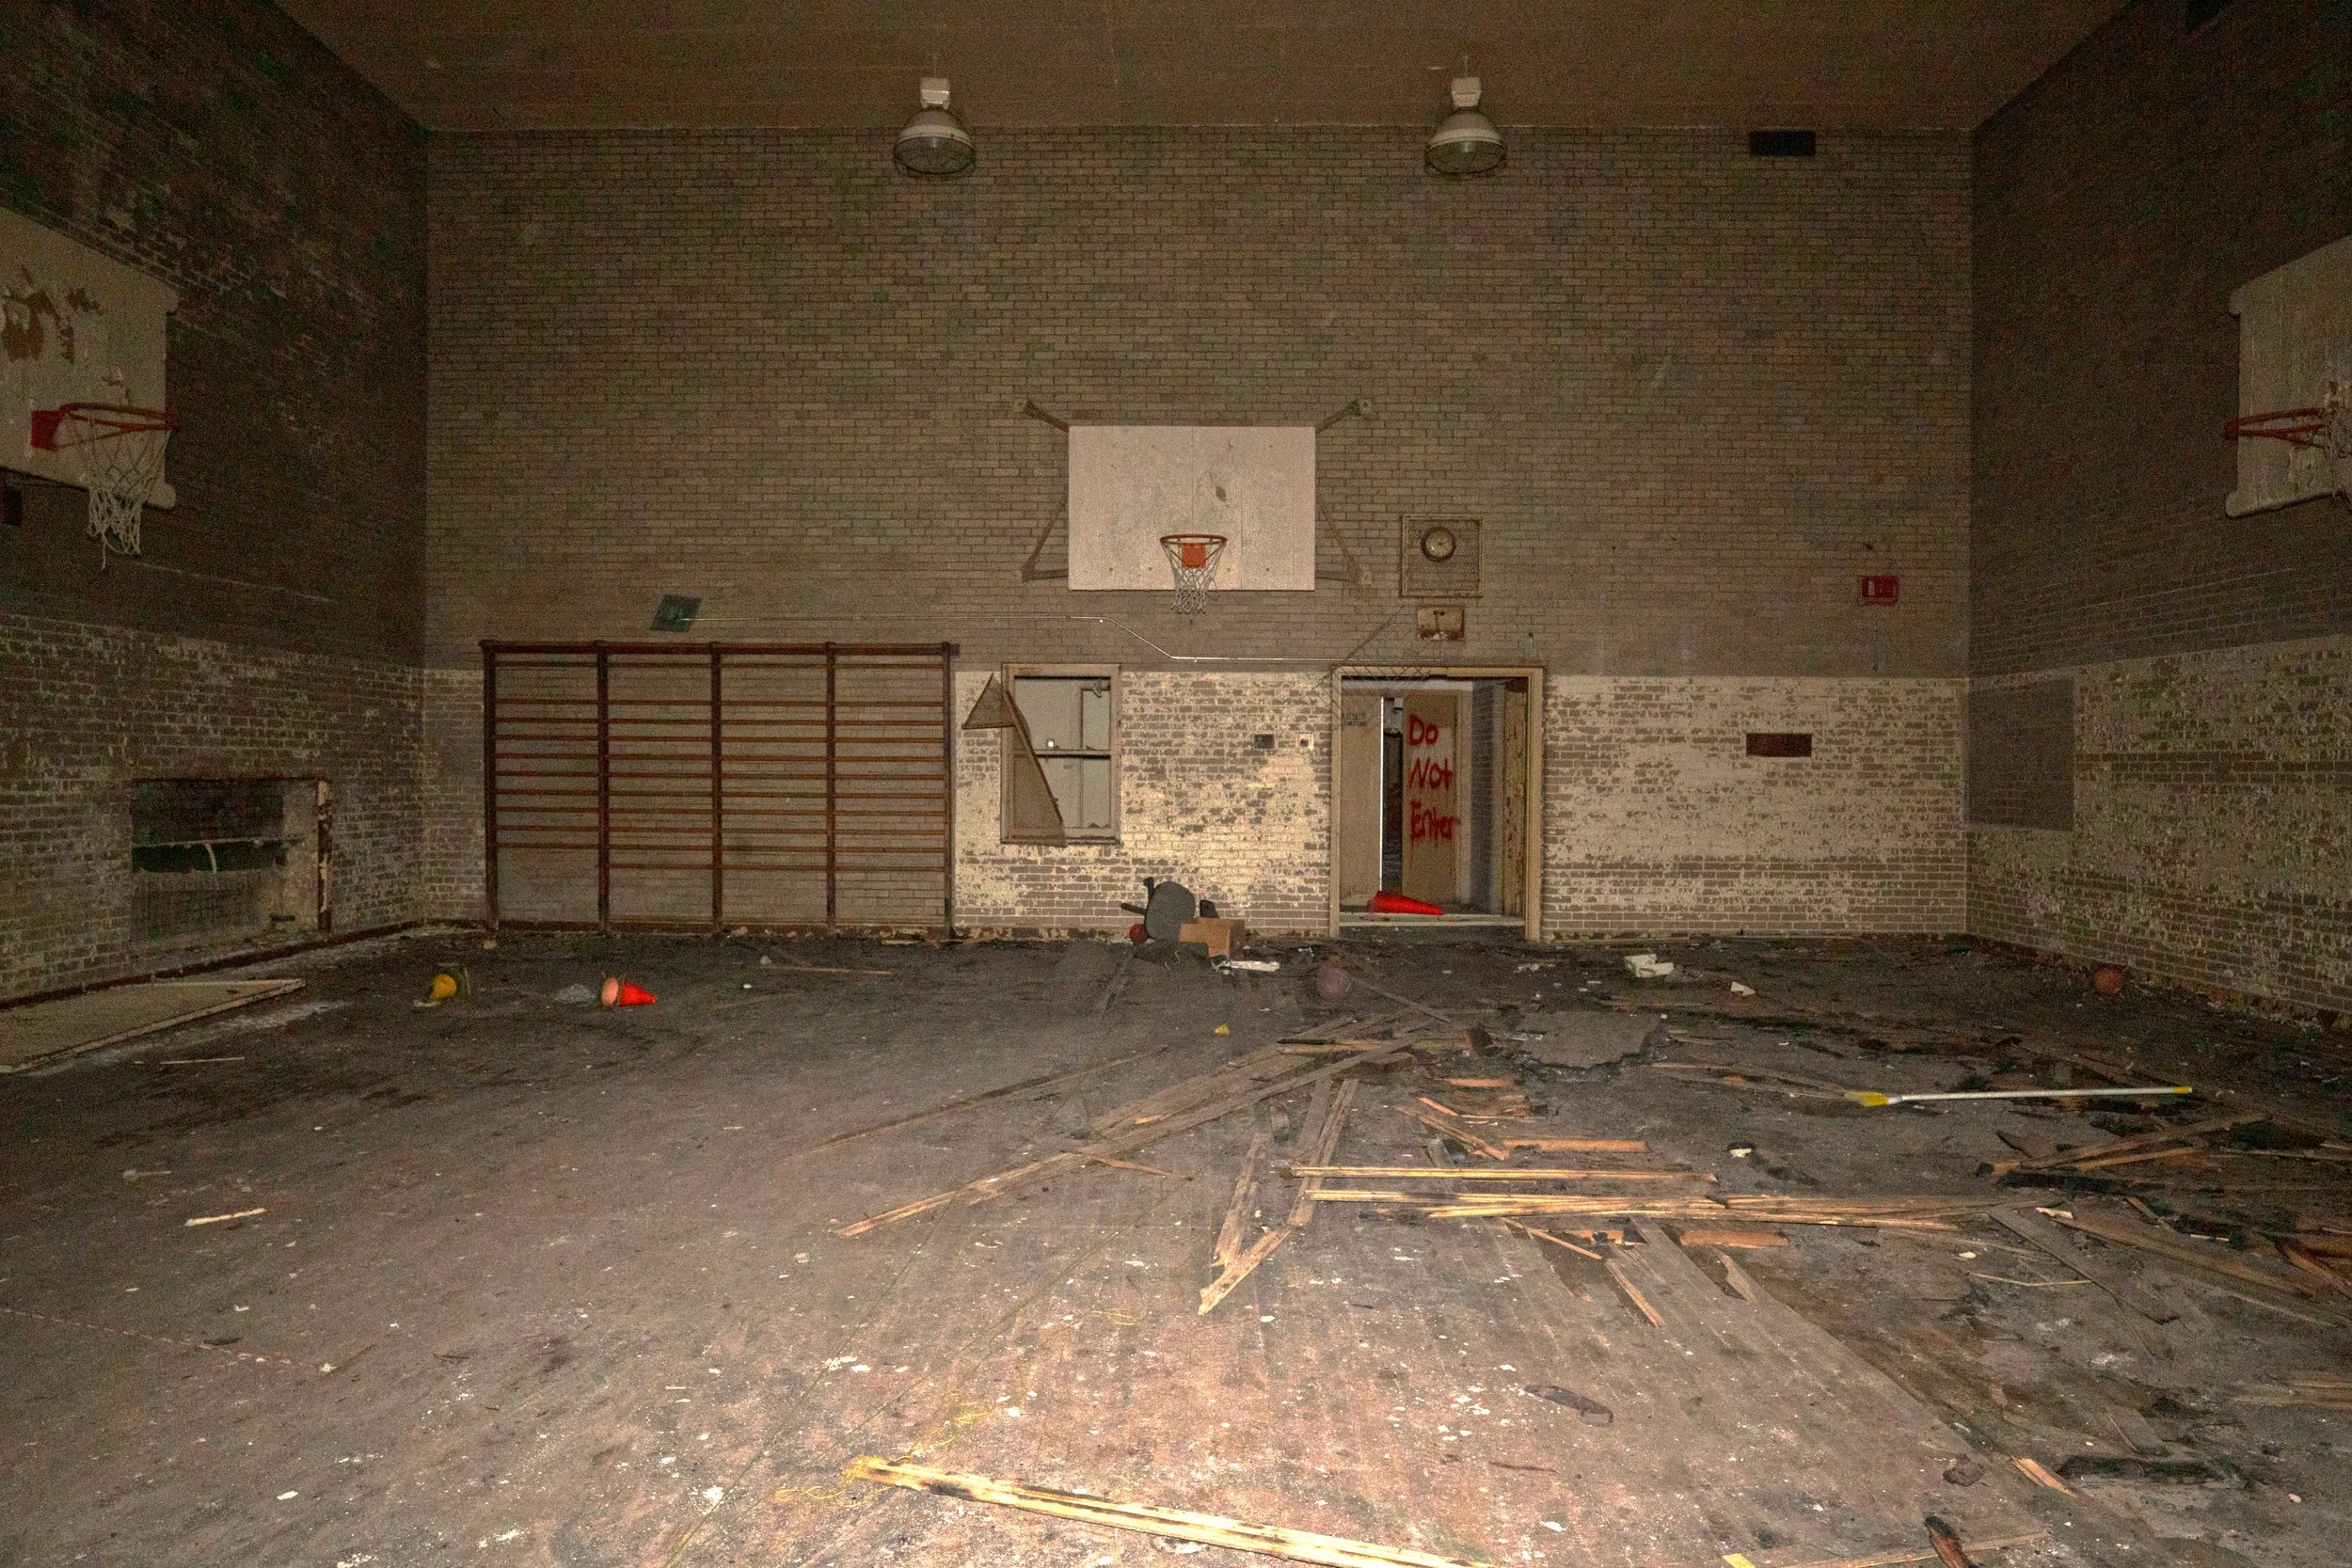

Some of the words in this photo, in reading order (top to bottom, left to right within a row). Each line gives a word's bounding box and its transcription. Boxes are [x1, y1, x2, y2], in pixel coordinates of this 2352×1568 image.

[1407, 714, 1438, 746] Do
[1407, 756, 1454, 791] Not
[1410, 799, 1460, 841] Enter
